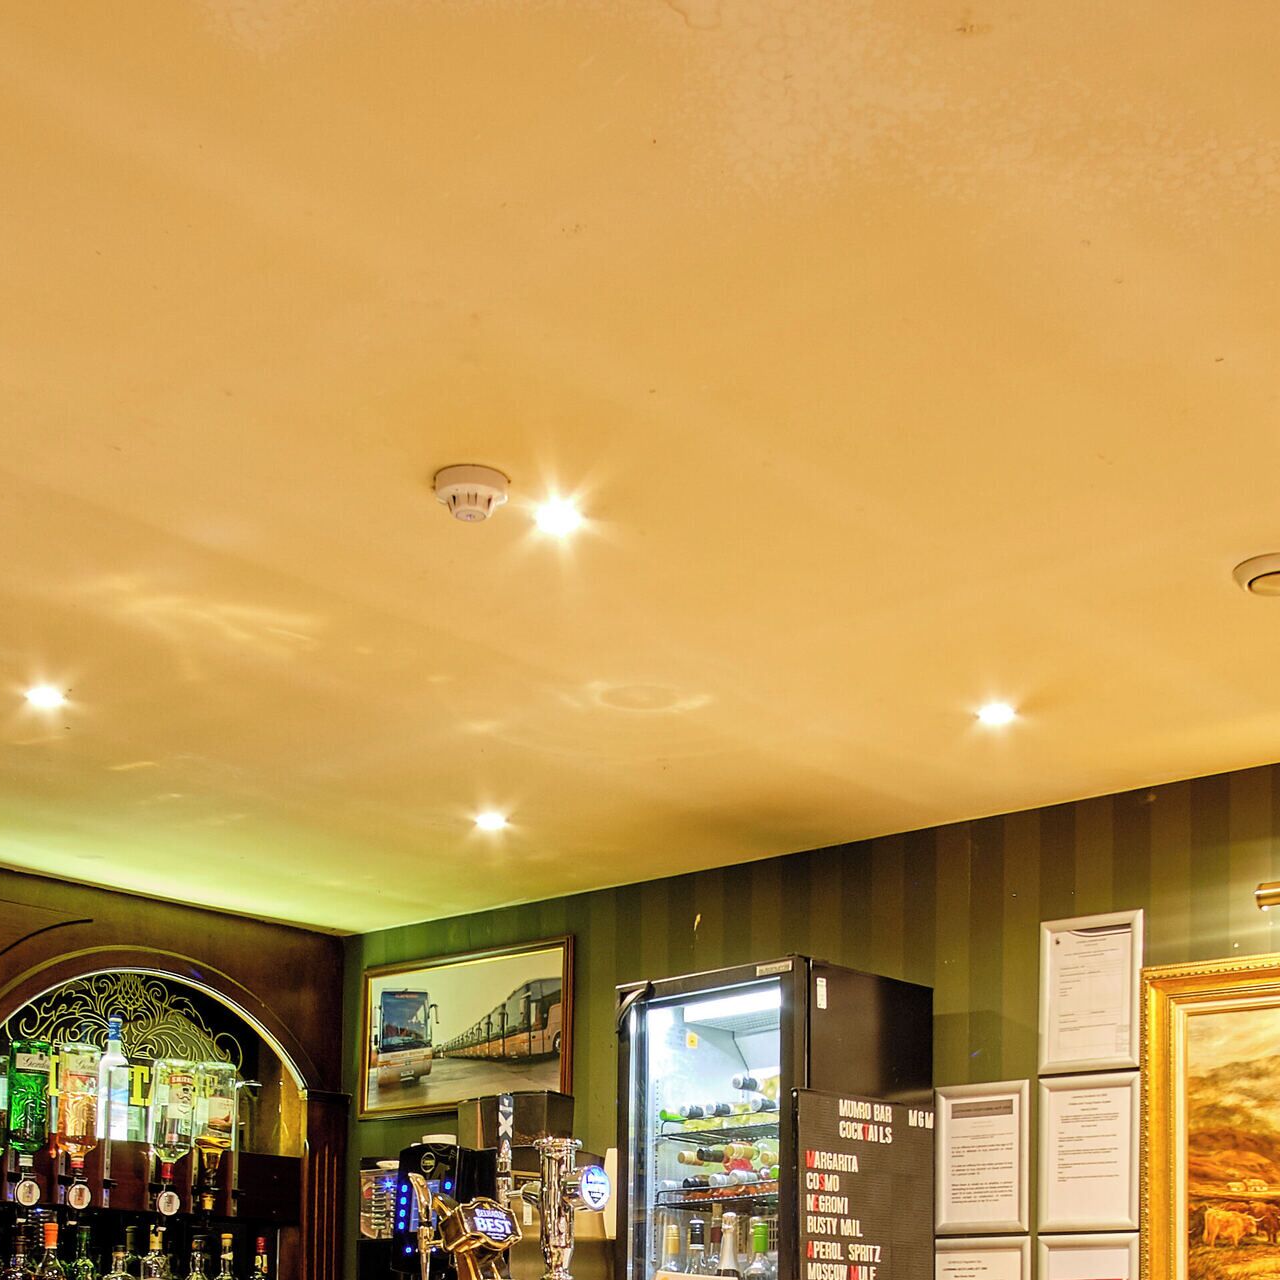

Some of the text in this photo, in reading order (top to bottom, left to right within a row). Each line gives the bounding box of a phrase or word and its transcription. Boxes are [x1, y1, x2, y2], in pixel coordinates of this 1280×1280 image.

[839, 1099, 892, 1123] MUNRO BAR
[839, 1120, 893, 1144] COCKTAILS
[806, 1150, 859, 1173] MARGARITA
[806, 1172, 840, 1192] COSMO
[806, 1194, 849, 1215] NEGRONI
[473, 1216, 512, 1235] BEST
[840, 1218, 864, 1237] NAIL
[807, 1240, 881, 1262] APEROL SPRITZ
